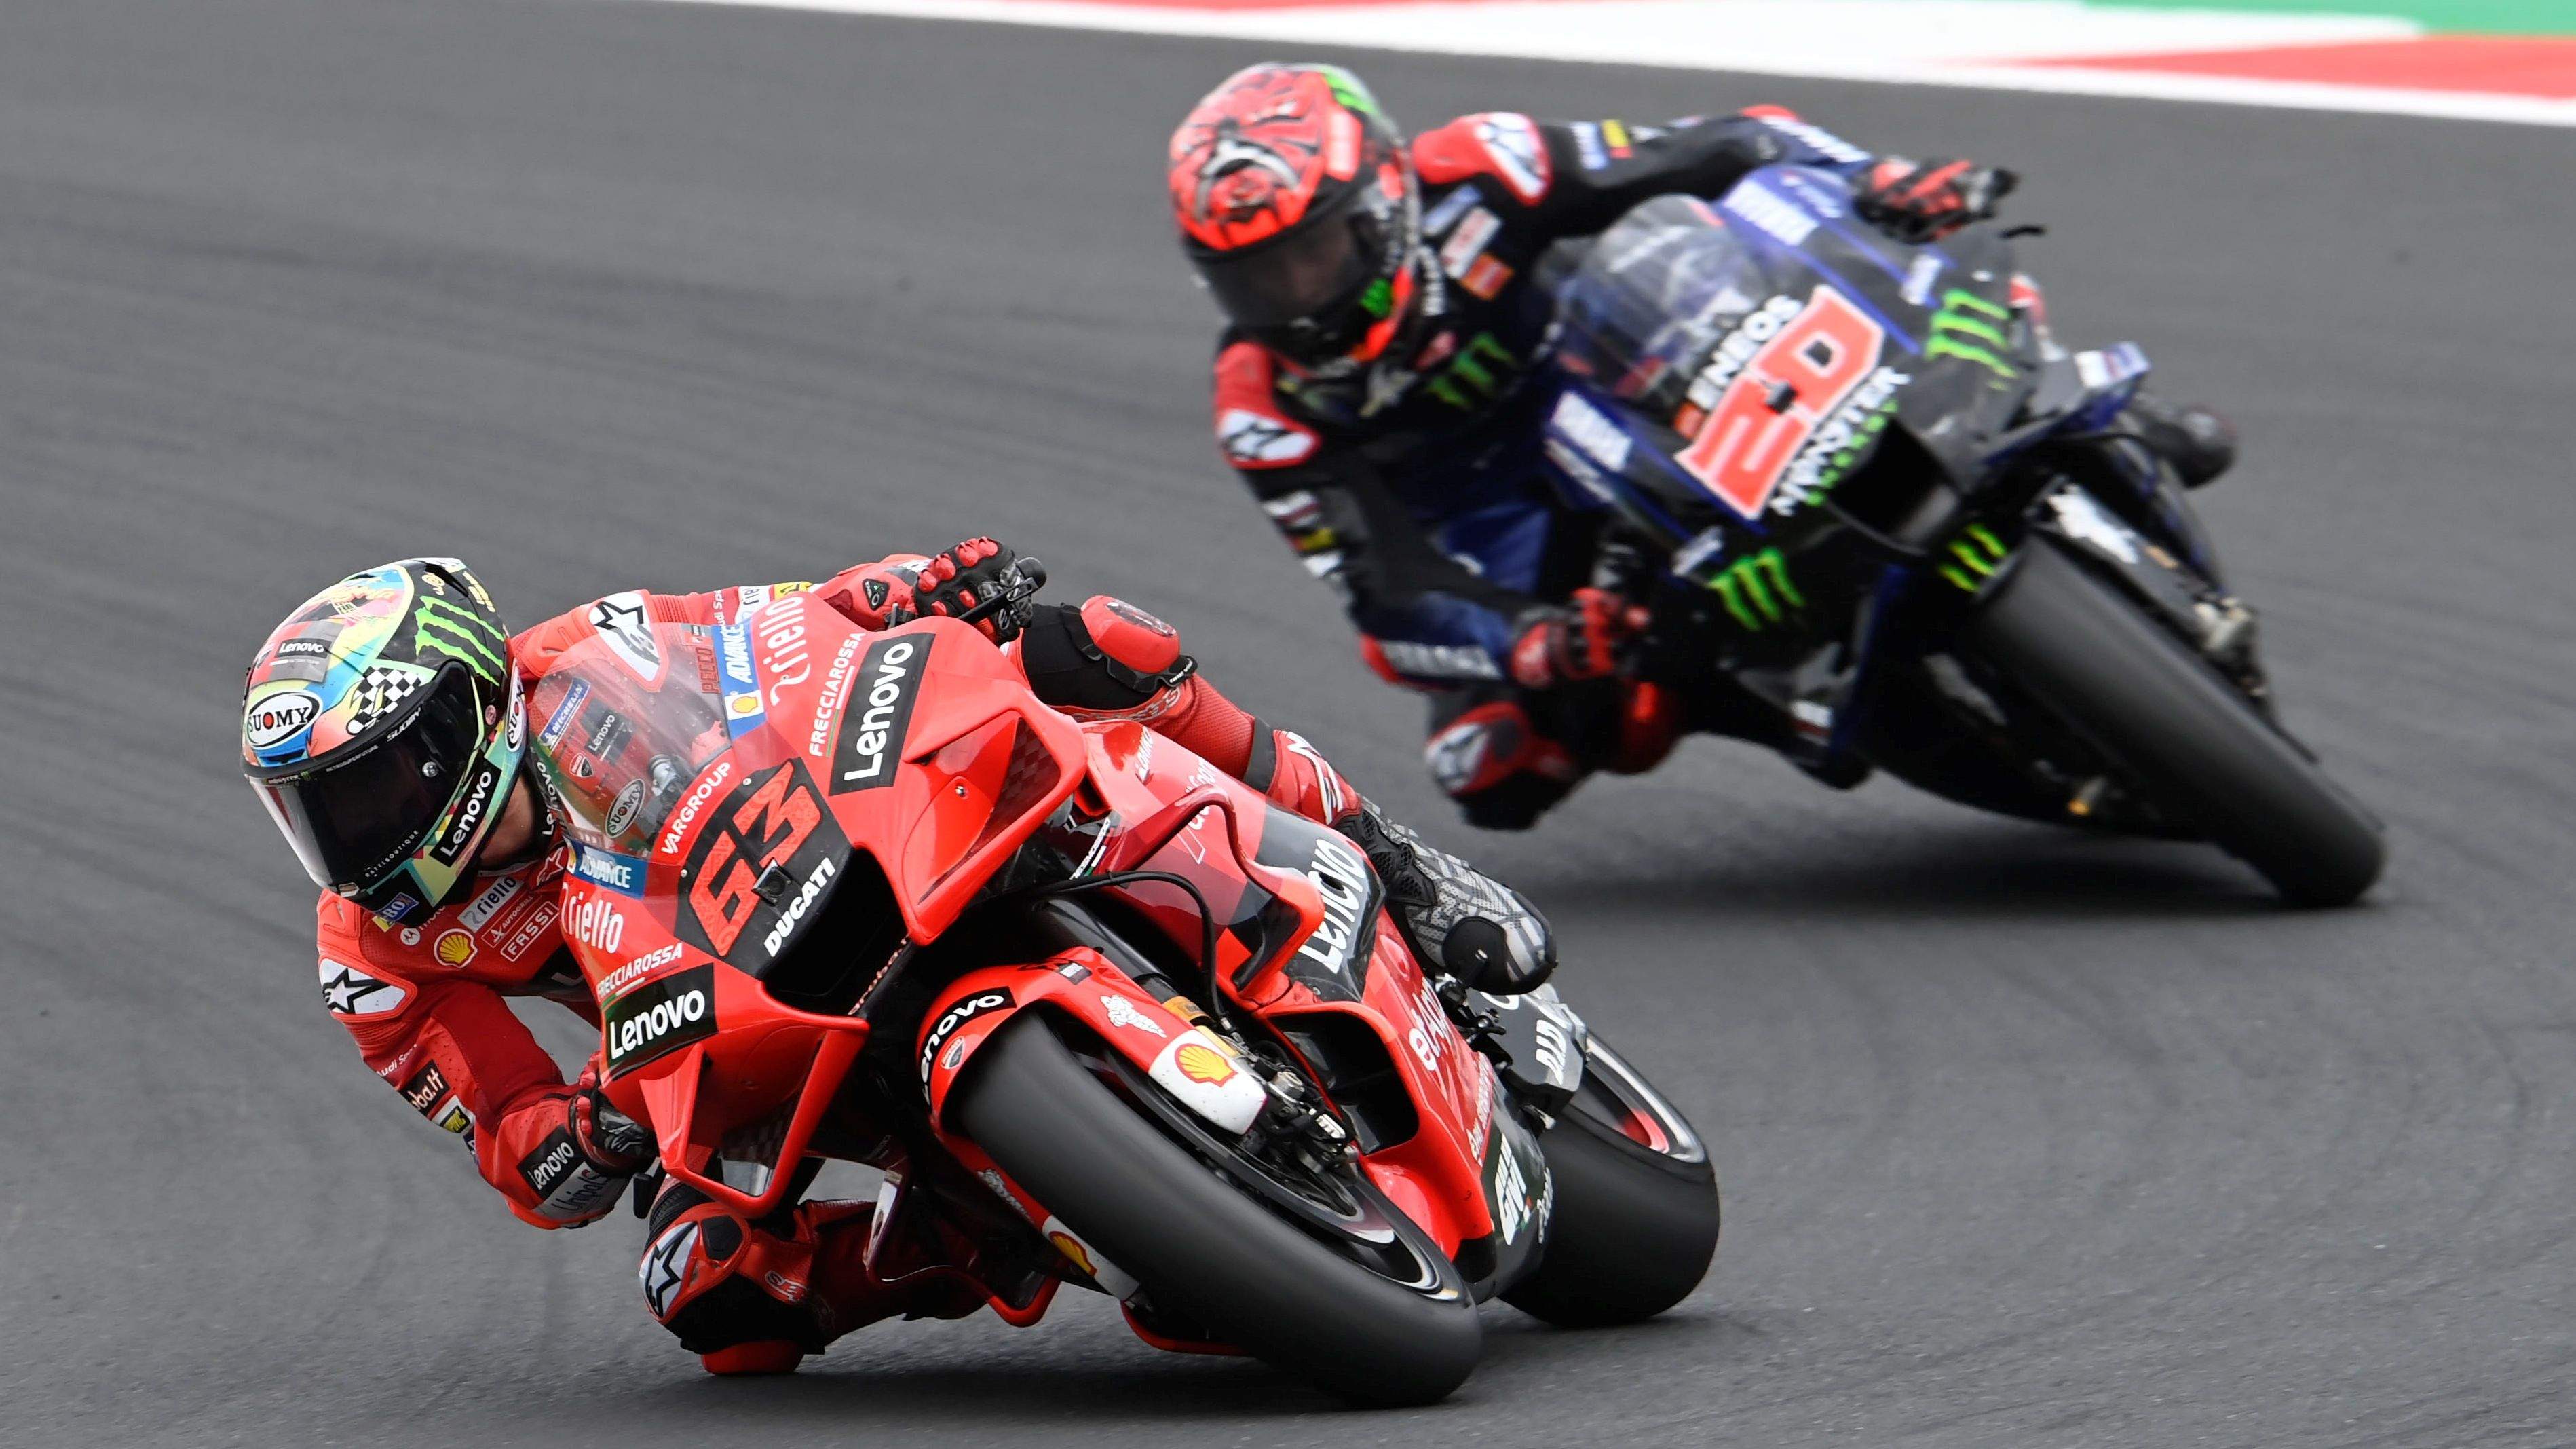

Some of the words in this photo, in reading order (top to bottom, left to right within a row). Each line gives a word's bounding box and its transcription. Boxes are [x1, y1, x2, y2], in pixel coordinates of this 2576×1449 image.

[1687, 294, 1805, 410] ENEOS
[278, 642, 325, 654] Lenovo
[720, 624, 753, 684] ADVANCE
[759, 596, 810, 673] riello
[696, 647, 721, 694] PECCO
[808, 631, 866, 757] FRECCIAROSSA
[247, 707, 310, 733] SUOMY
[588, 715, 615, 752] Lenovo
[843, 642, 914, 782] Lenovo
[440, 770, 492, 857] Lenovo
[661, 761, 731, 854] VARGROUP
[579, 853, 632, 888] ADVANCE
[689, 761, 821, 957] 63
[476, 876, 517, 915] riello
[569, 891, 624, 954] riello
[763, 857, 836, 958] DUCATI
[1298, 838, 1366, 974] Lenovo
[507, 906, 554, 956] FASSI
[609, 990, 706, 1060] Lenovo
[527, 1142, 574, 1190] Lenovo
